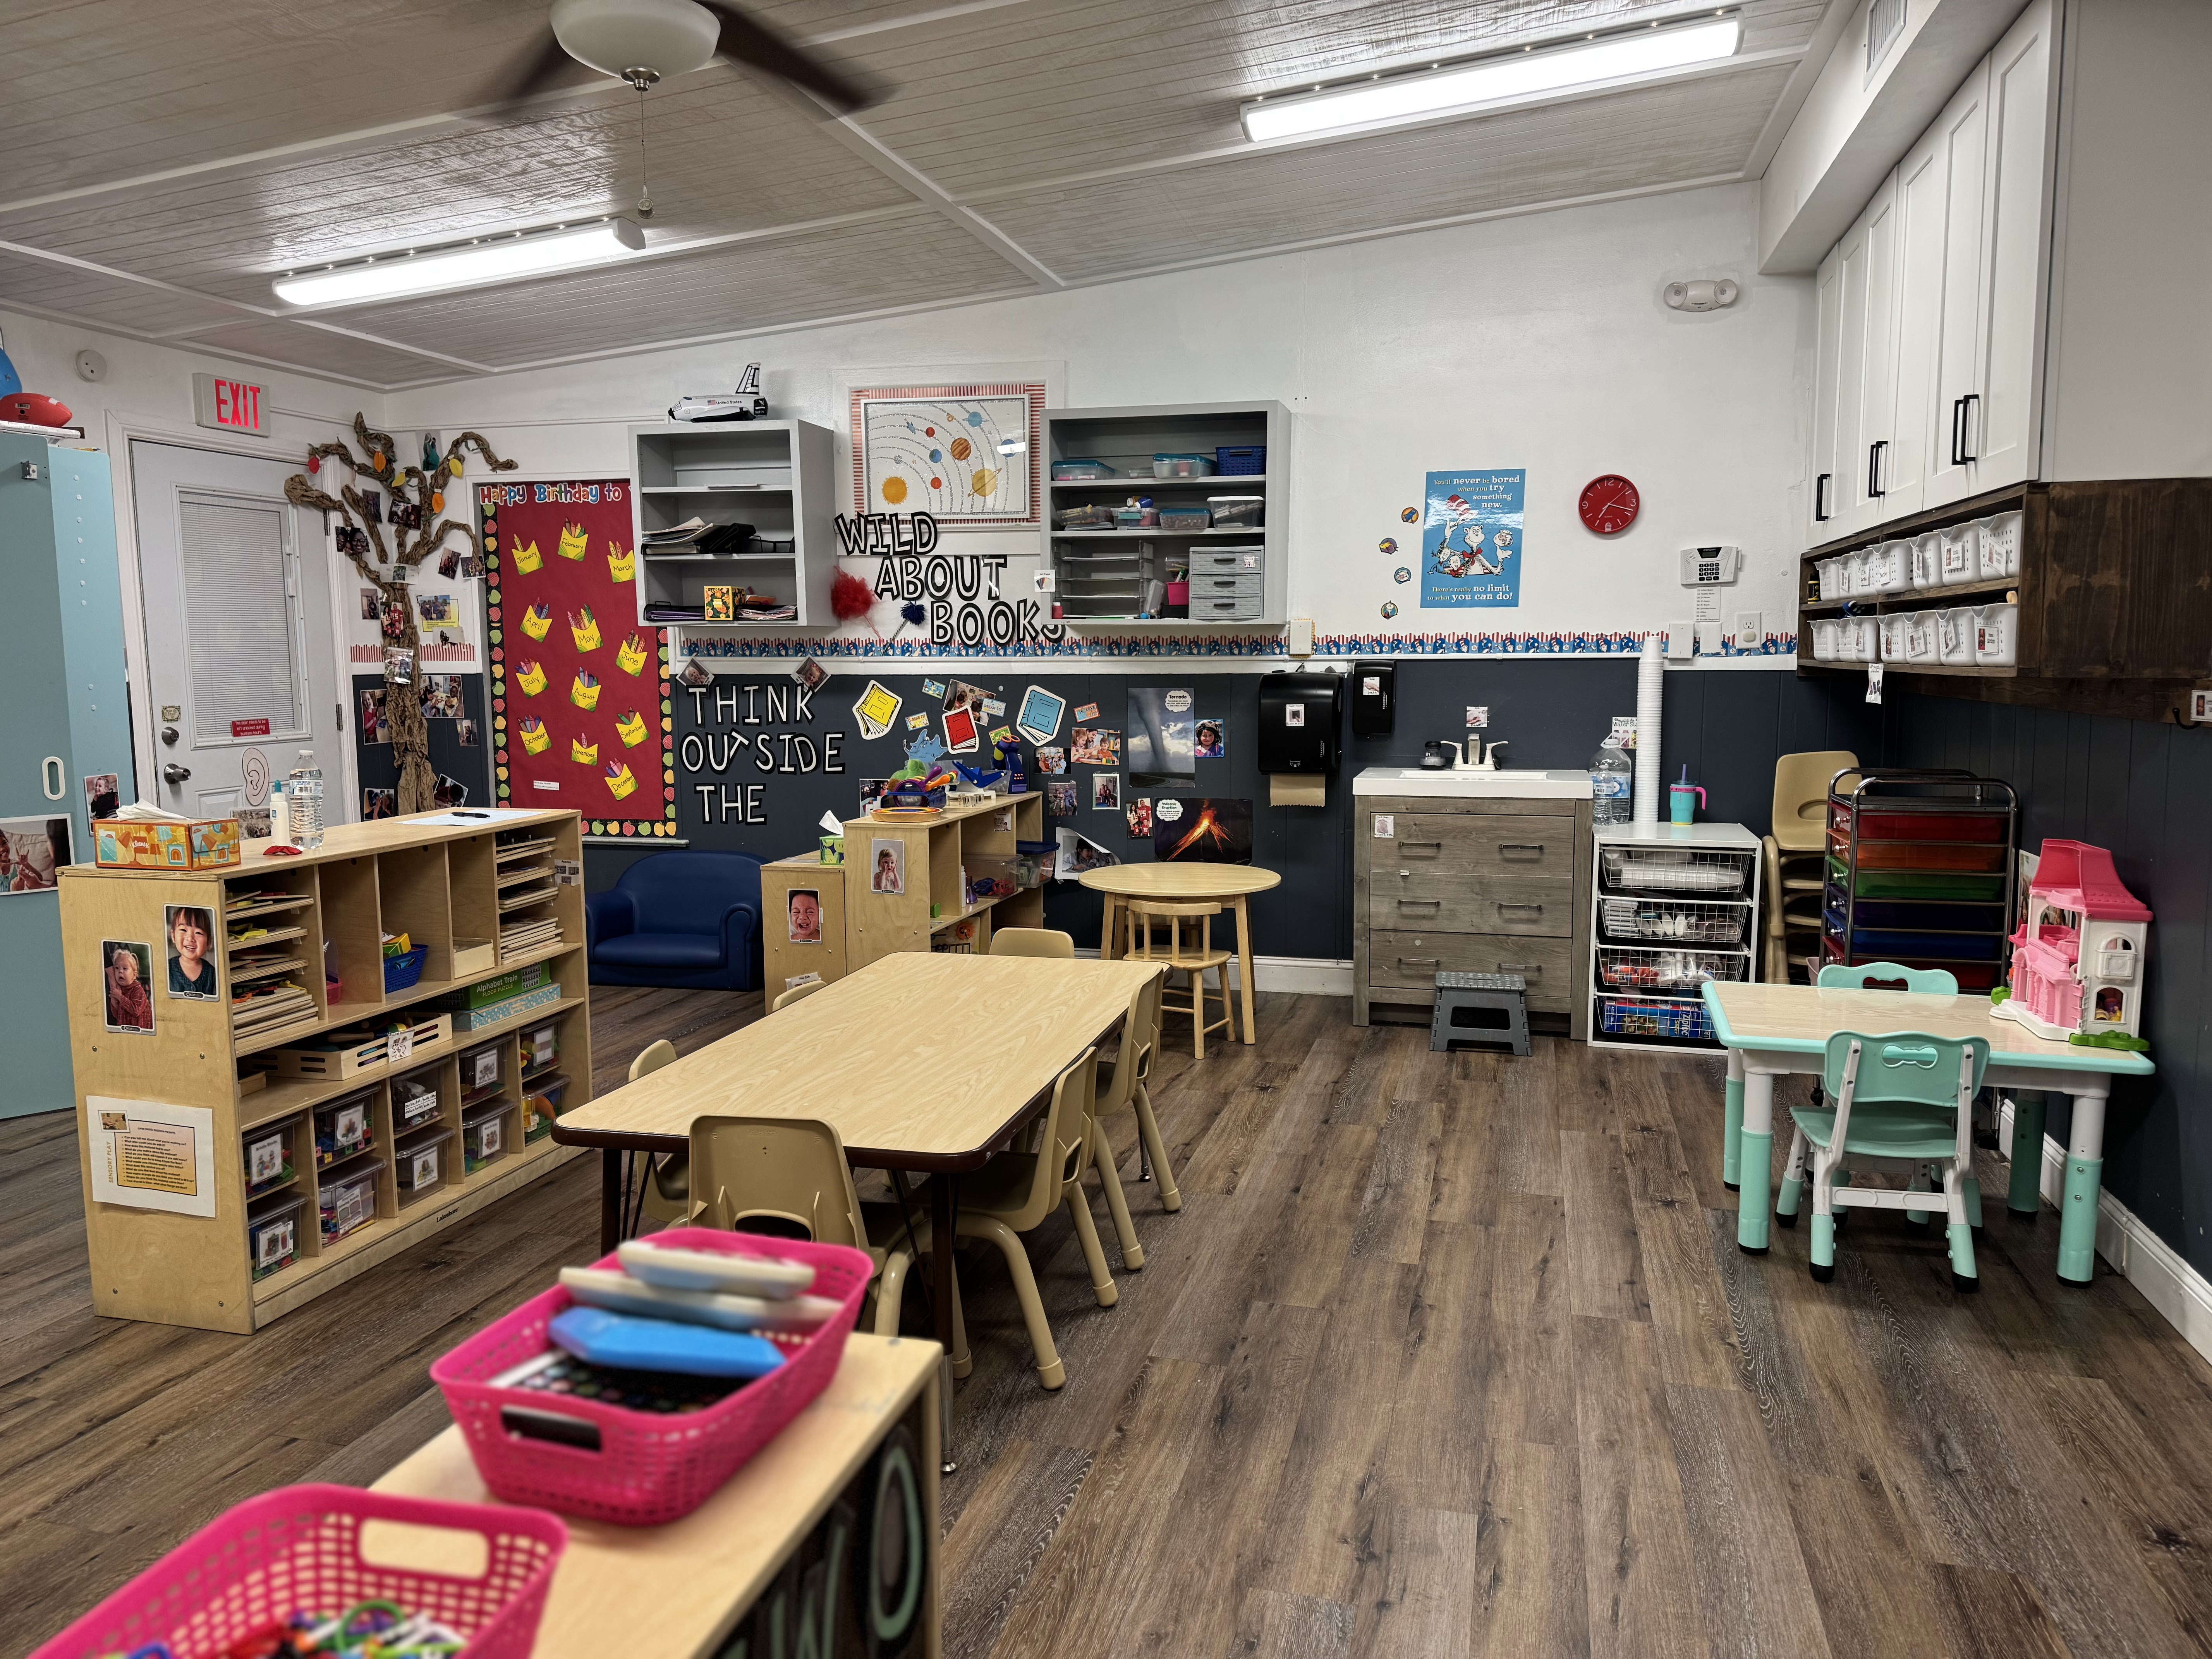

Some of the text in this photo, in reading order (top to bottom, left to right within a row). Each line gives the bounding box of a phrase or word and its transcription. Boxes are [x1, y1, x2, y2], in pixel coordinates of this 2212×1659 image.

[215, 379, 260, 430] EXIT
[1492, 475, 1520, 483] bored
[480, 483, 622, 507] Happy Birthday to
[835, 512, 937, 555] WILD
[562, 538, 584, 550] February
[517, 551, 537, 564] January
[613, 563, 633, 573] March
[875, 555, 1007, 601] ABOUT
[1451, 594, 1472, 603] you
[526, 617, 543, 631] April
[578, 634, 594, 646] May
[621, 650, 639, 666] June
[524, 676, 540, 687] July
[574, 687, 595, 701] August
[687, 683, 814, 725] THINK
[524, 732, 547, 746] October
[620, 724, 644, 739] September
[573, 747, 596, 758] November
[680, 728, 845, 775] OUTSIDE
[611, 775, 634, 792] December
[694, 783, 767, 825] THE
[131, 840, 149, 848] Kleenex
[477, 975, 518, 993] Alphabet Train
[498, 983, 513, 992] PUZZLE
[1681, 1012, 1690, 1035] Ziploc
[436, 1208, 458, 1223] Lakeshore
[725, 1446, 923, 1659] WO
